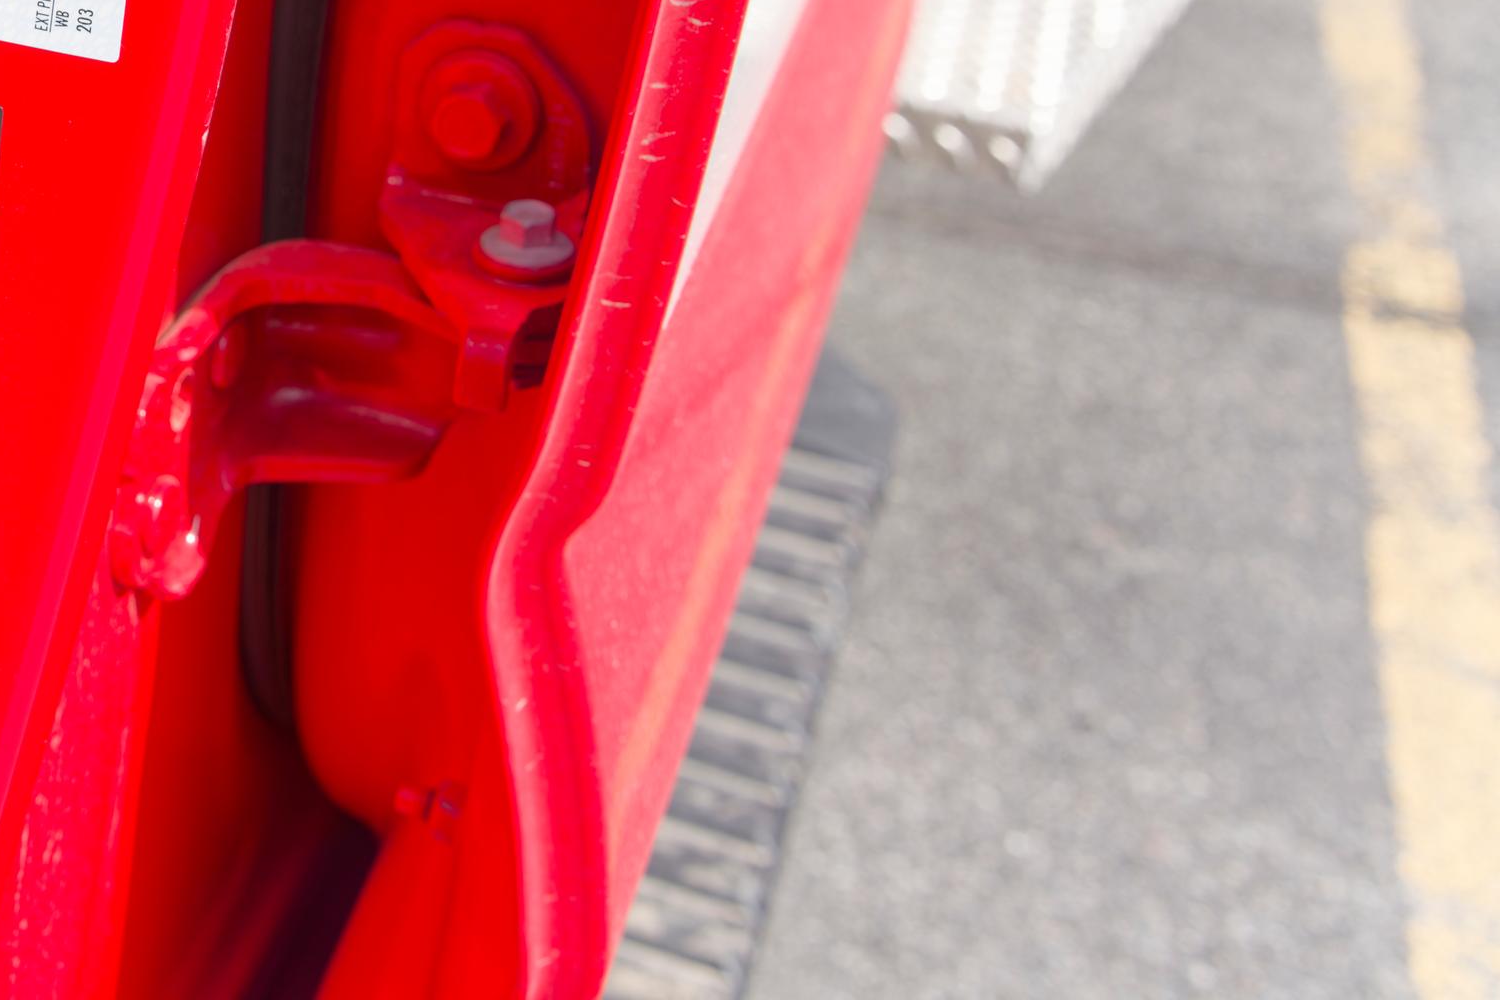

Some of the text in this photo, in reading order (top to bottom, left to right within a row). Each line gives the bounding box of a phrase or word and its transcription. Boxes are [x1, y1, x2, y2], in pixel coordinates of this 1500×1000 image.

[34, 10, 49, 31] EXT
[54, 10, 69, 27] WB
[76, 8, 94, 33] 203
